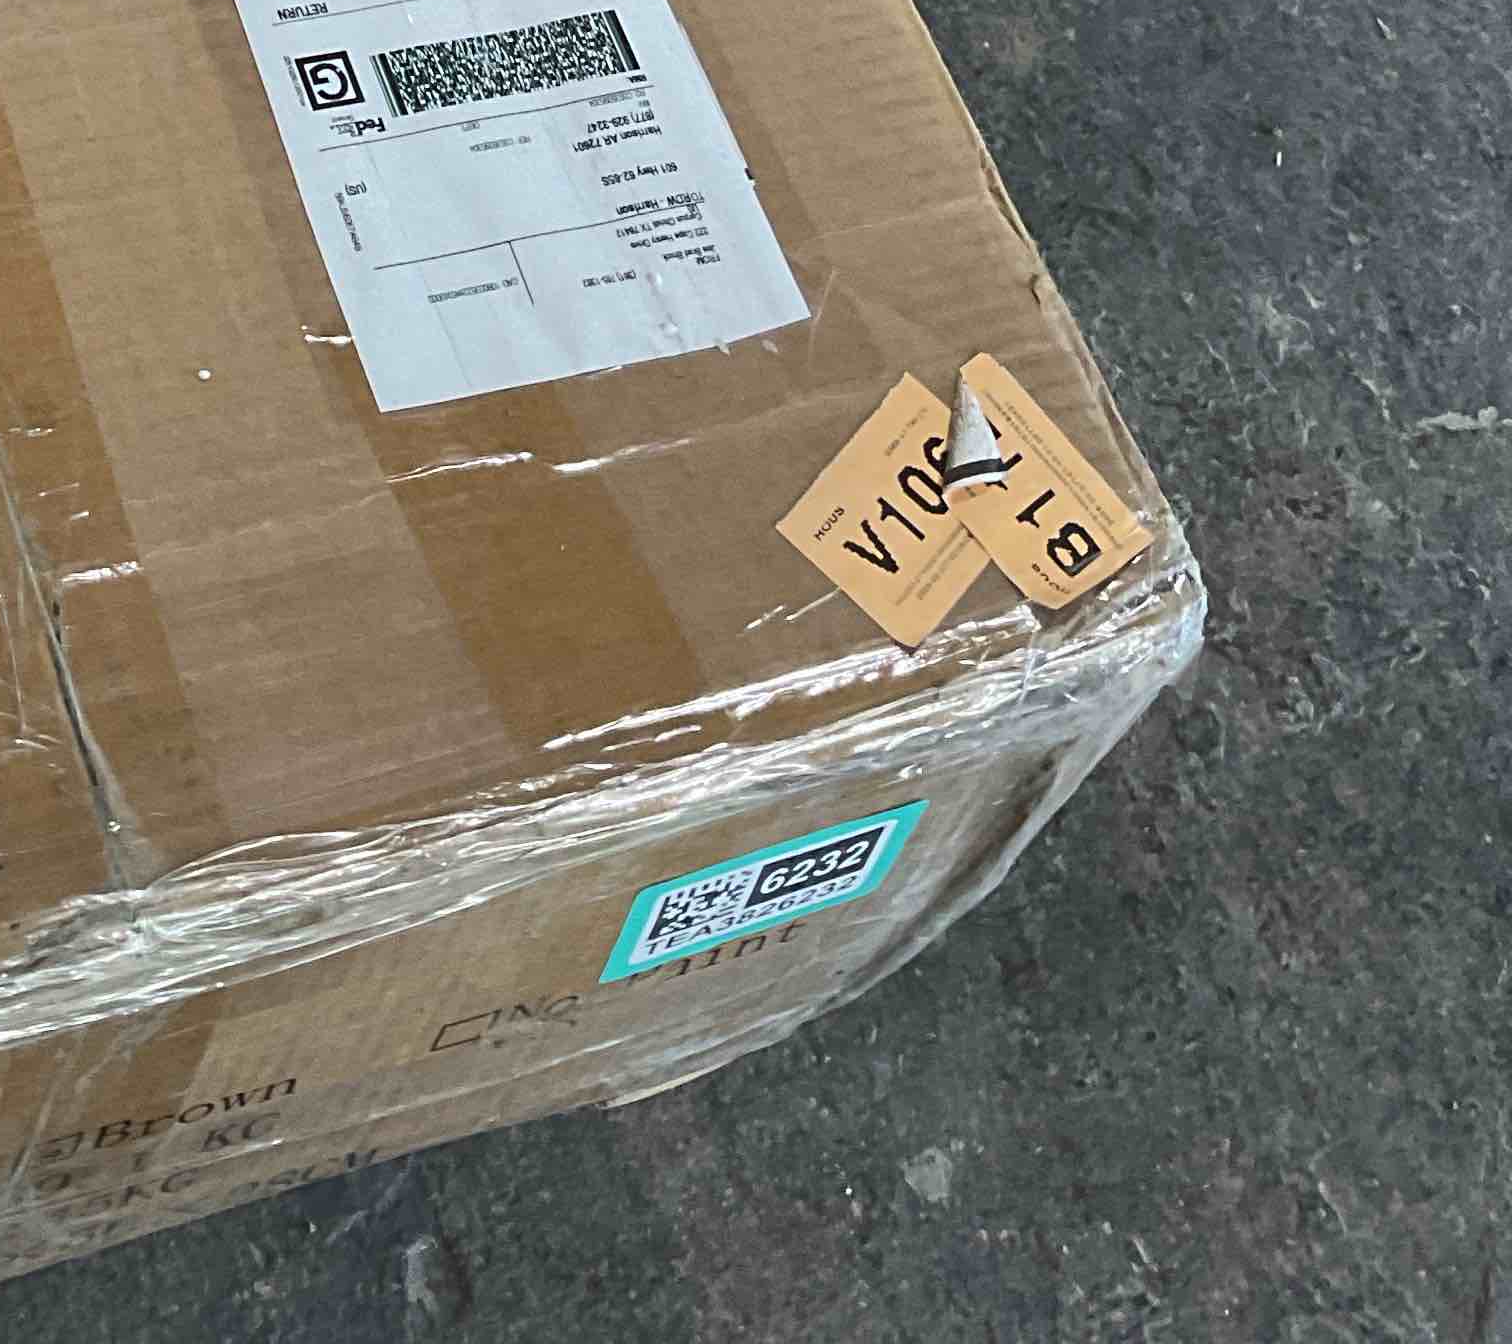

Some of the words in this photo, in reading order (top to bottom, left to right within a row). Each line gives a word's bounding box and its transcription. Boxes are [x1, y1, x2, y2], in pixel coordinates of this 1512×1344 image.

[277, 1, 329, 20] RETURN
[308, 62, 349, 101] G
[602, 134, 618, 146] AR
[619, 124, 662, 140] Harrison
[616, 198, 660, 216] Harrison
[759, 840, 871, 895] 6232
[643, 874, 861, 957] TEA3826232
[92, 1077, 297, 1151] Brown
